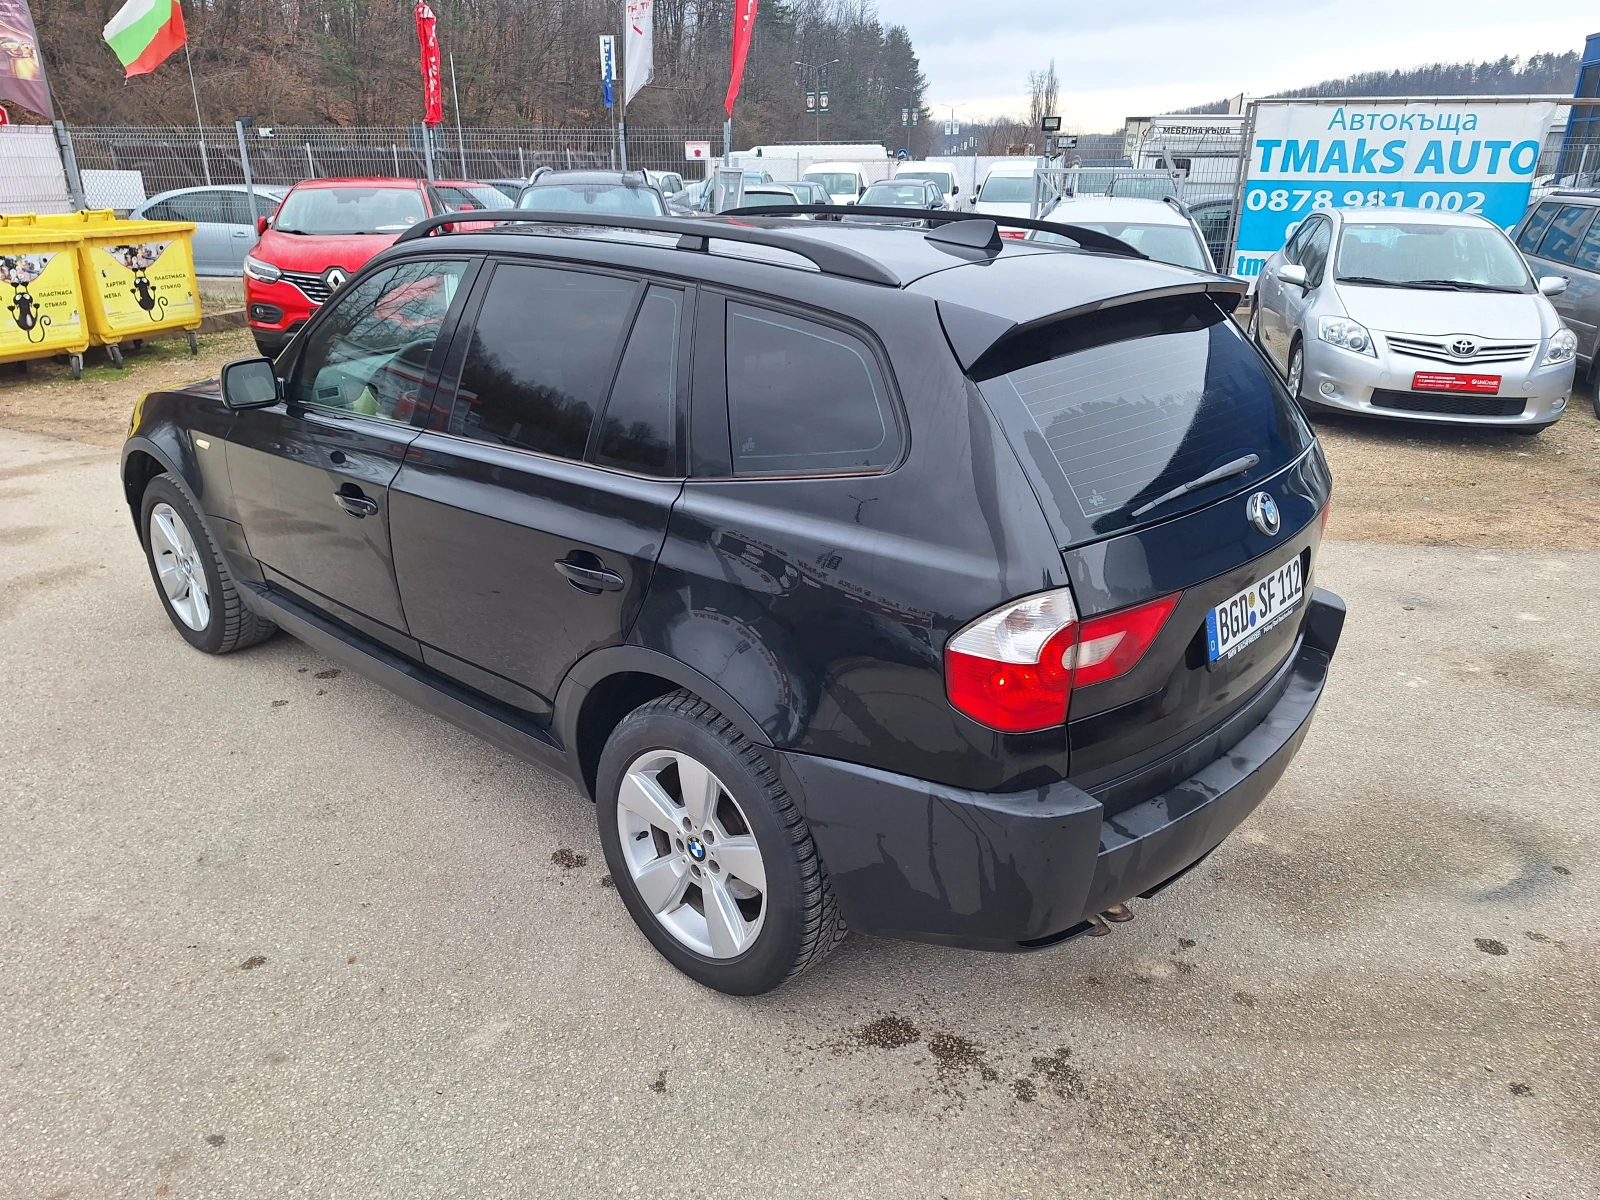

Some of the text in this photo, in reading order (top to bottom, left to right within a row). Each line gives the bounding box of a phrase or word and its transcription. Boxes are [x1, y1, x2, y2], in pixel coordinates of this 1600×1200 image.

[1328, 107, 1478, 135] Автокъща
[1162, 126, 1203, 135] МЕБЕЛНА
[1256, 138, 1540, 176] TMAkS AUTO
[1246, 188, 1486, 214] 0878 981 002
[154, 273, 187, 281] ПЛАСТМАСА
[105, 280, 126, 288] ХАРТИЯ
[104, 292, 121, 300] МЕТАЛ
[44, 300, 68, 308] СТЪКЛО
[1219, 560, 1301, 647] BGD SF 112
